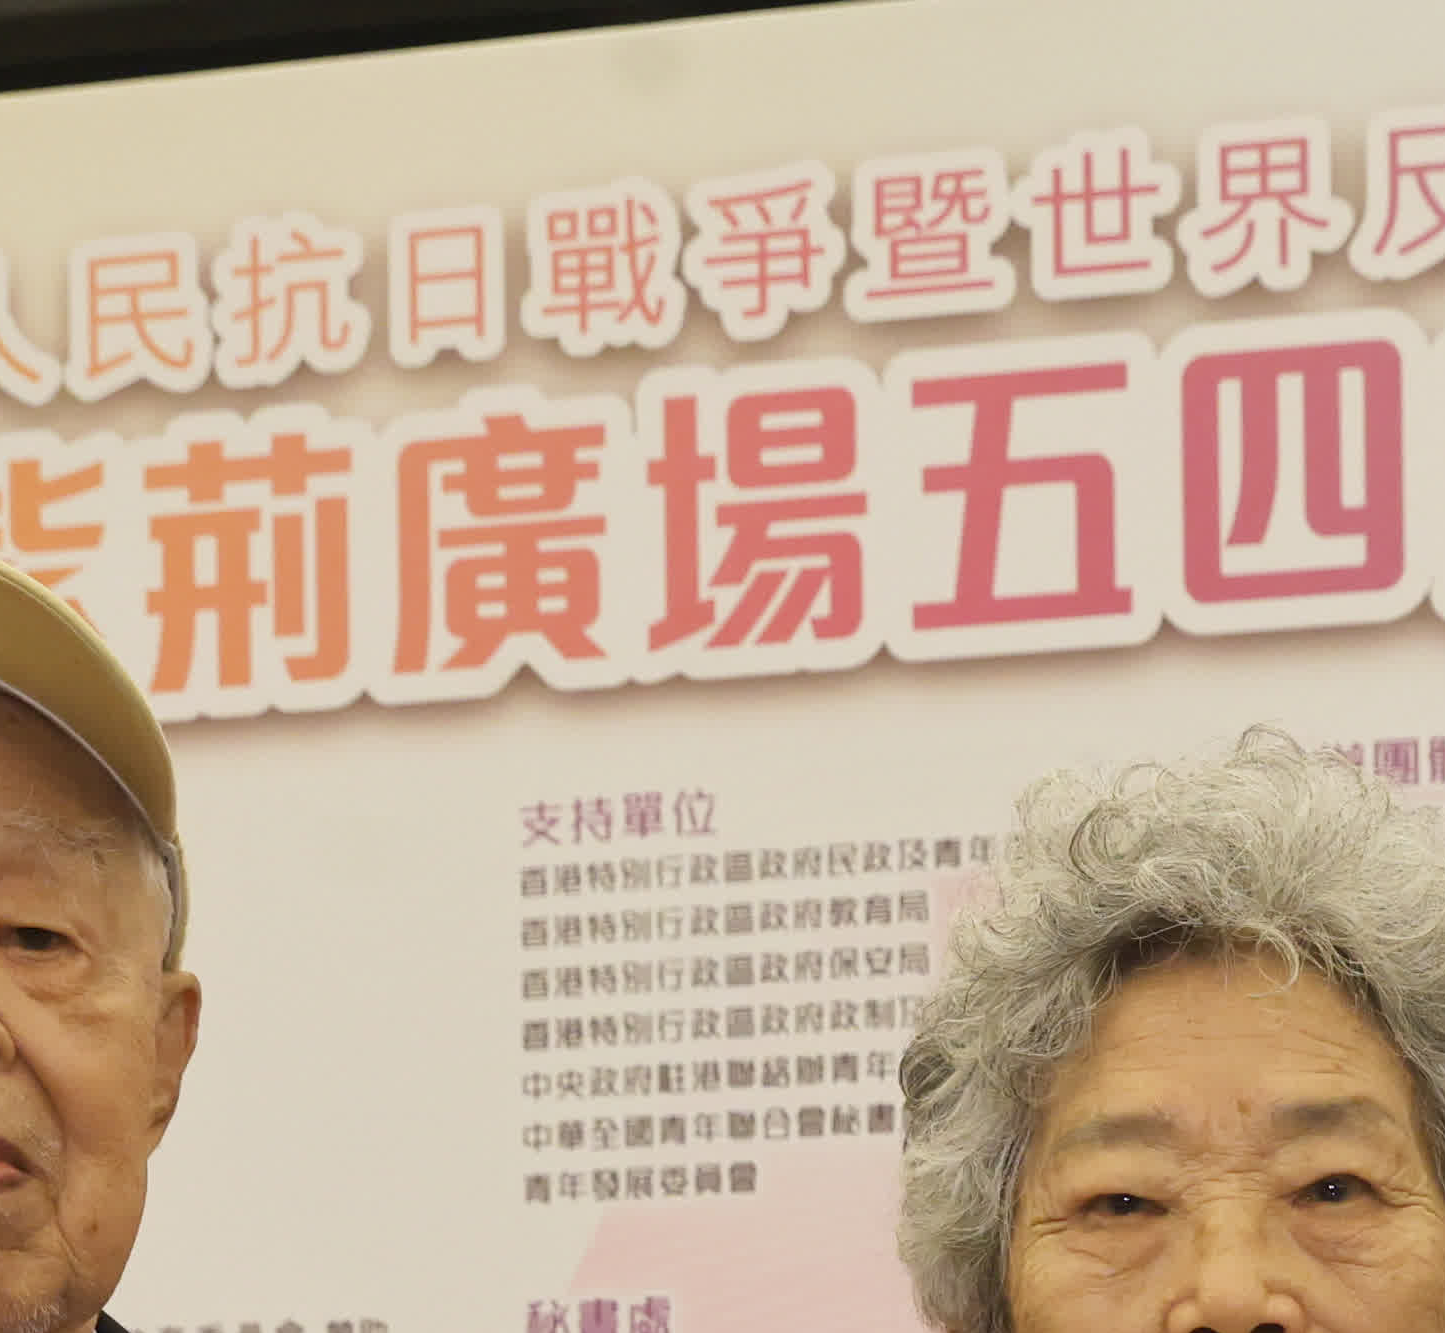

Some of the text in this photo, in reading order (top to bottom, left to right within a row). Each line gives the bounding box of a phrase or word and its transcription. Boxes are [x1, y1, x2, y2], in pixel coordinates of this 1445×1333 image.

[520, 790, 718, 847] 支持單位
[521, 891, 930, 950] 香港特別行政區政府教育局
[521, 943, 931, 1001] 香港特別行政區政府保安局
[524, 1160, 758, 1205] 青年發展委員會
